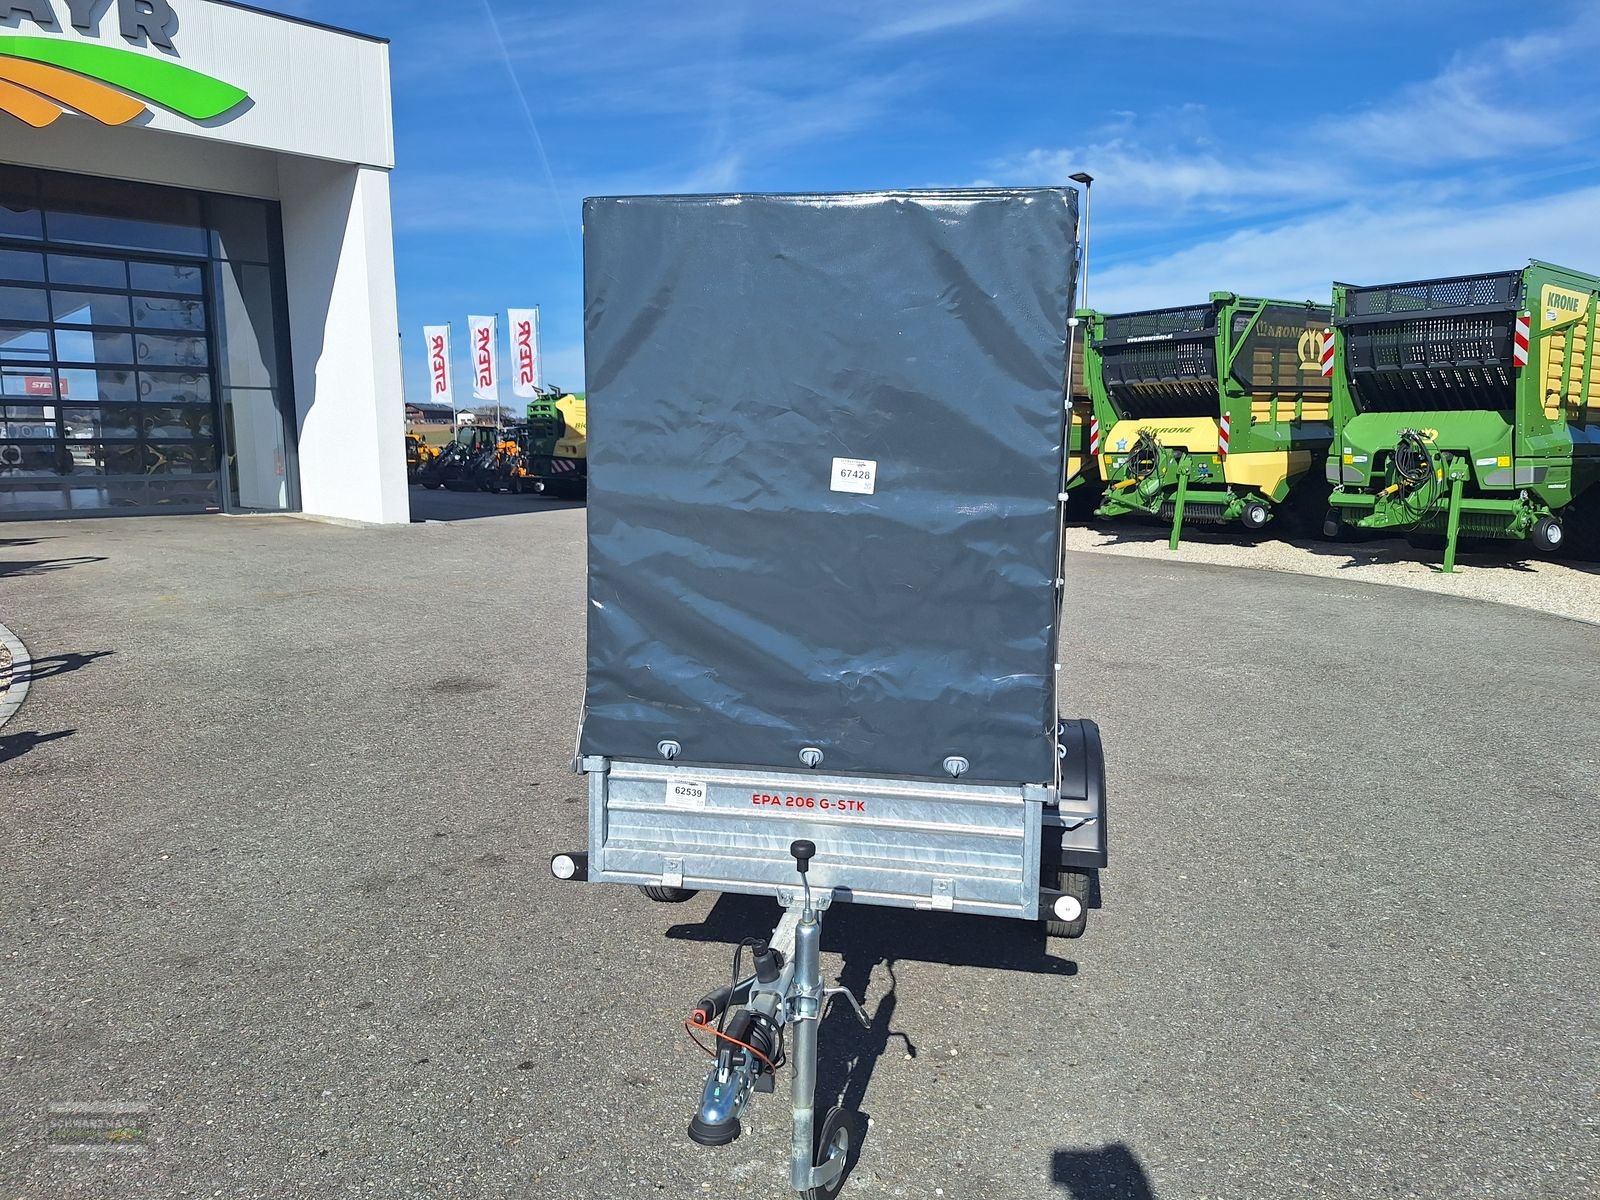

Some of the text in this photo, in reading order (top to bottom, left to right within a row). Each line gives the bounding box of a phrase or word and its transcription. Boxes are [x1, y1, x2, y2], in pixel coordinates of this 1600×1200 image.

[1547, 291, 1580, 313] KRONE
[1152, 426, 1195, 434] KRONE
[840, 468, 871, 480] 67428
[674, 786, 703, 798] 62539
[752, 794, 867, 812] EPA 206 G-STK
